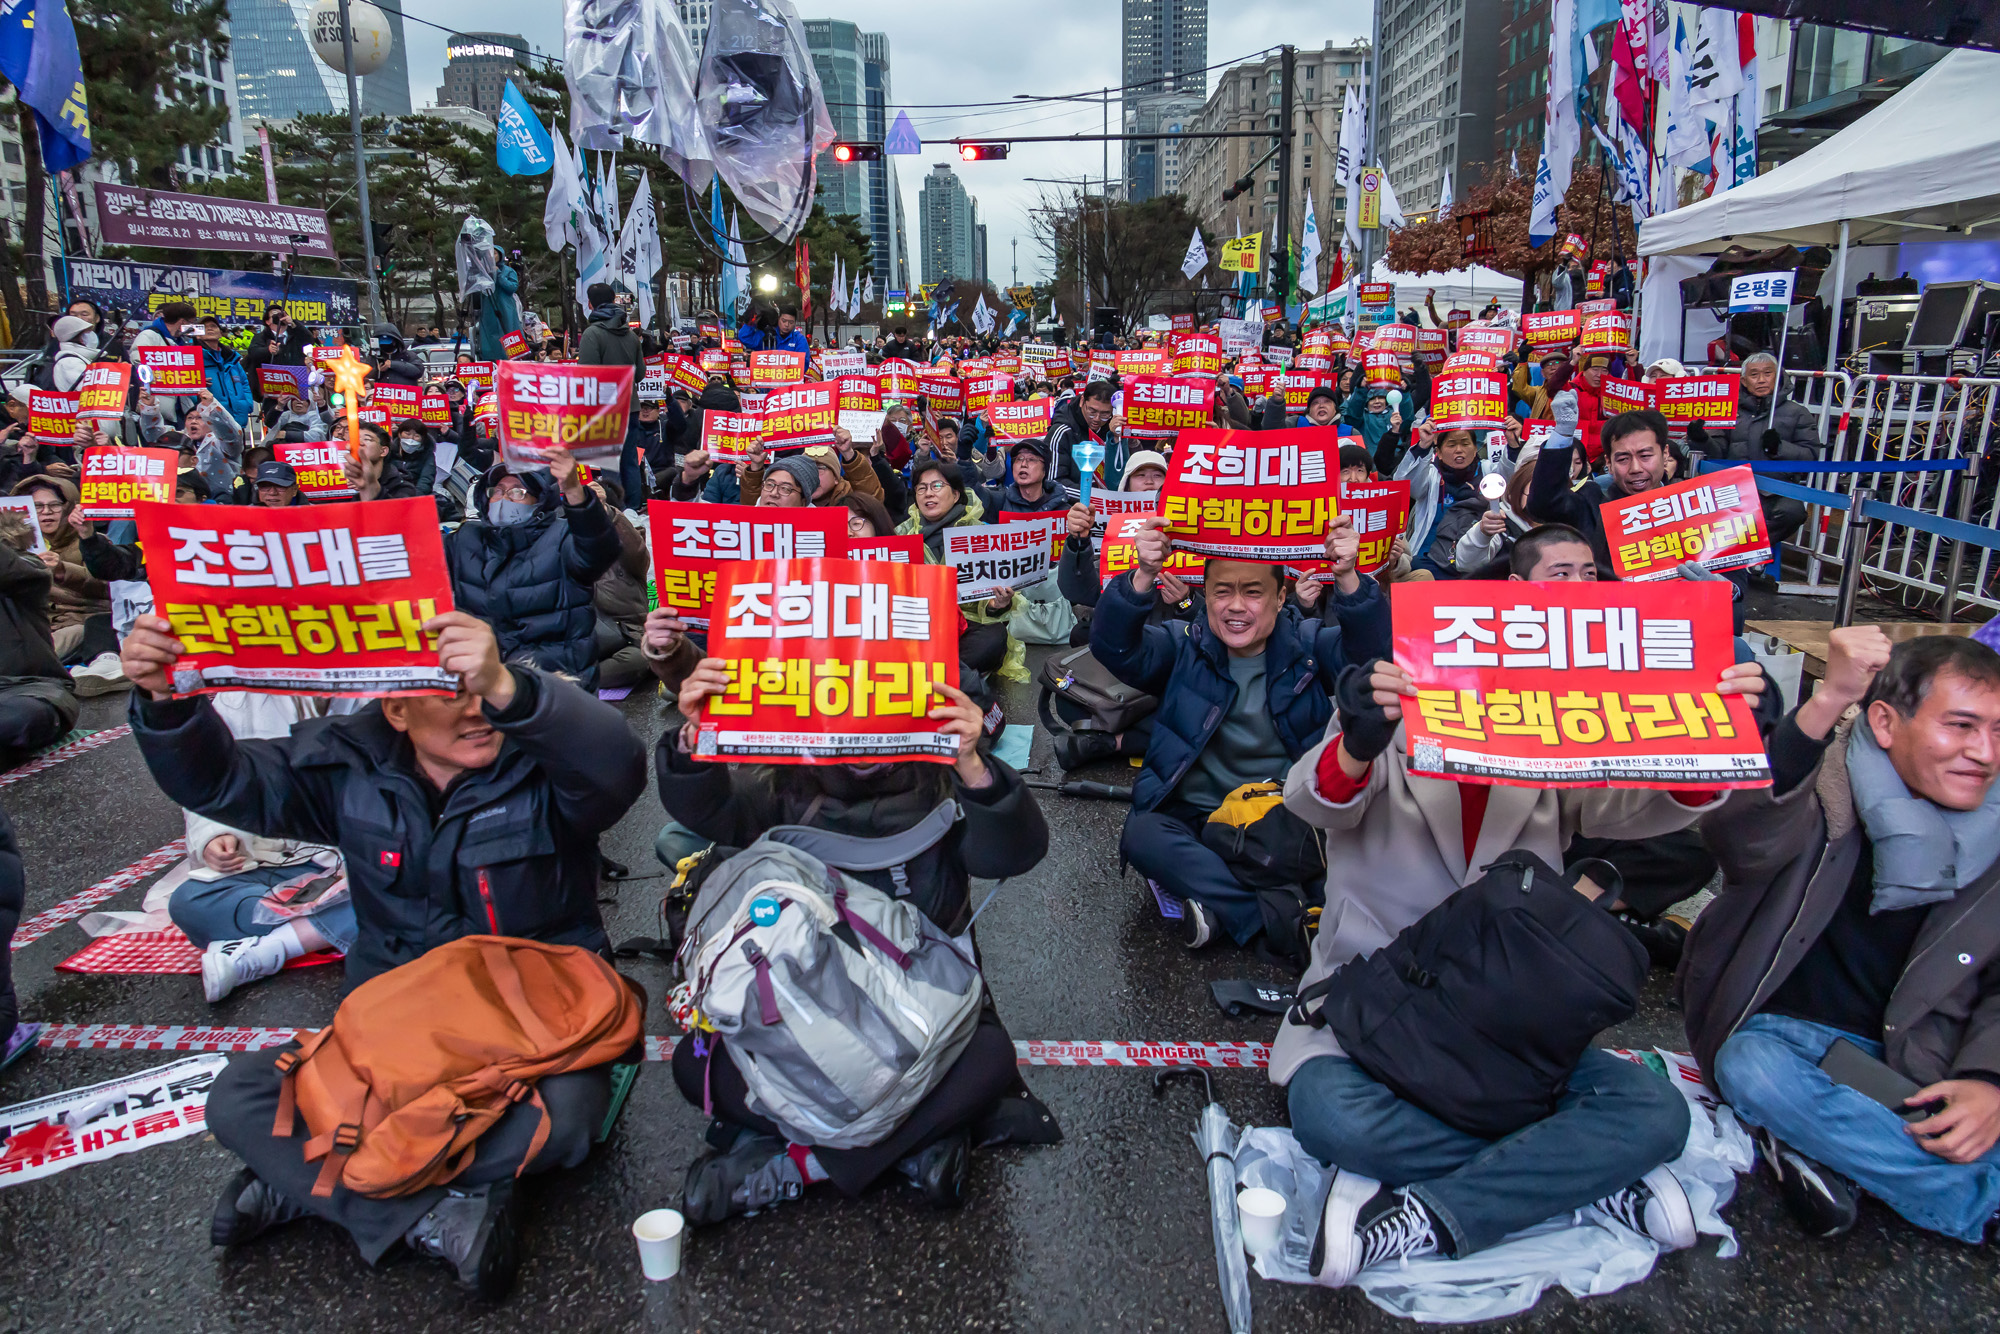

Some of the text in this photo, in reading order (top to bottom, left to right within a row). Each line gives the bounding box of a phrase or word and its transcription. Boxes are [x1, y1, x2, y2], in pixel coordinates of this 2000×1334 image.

[731, 36, 754, 48] 212
[71, 262, 132, 290] 재판이
[1734, 278, 1787, 300] 은평을
[234, 298, 266, 320] 즉각
[1529, 314, 1574, 329] 조희대를
[1463, 332, 1505, 344] 조희대를
[1526, 327, 1577, 344] 탄핵하라!
[1177, 339, 1217, 354] 조희대를
[144, 352, 195, 366] 조희대를
[757, 354, 799, 366] 조희대를
[825, 356, 863, 367] 특별재판부
[1121, 353, 1162, 362] 조희대를
[1173, 356, 1219, 372] 탄핵하라!
[1449, 354, 1490, 367] 조희대를
[83, 369, 121, 386] 희대를
[152, 370, 202, 384] 핵하라!
[460, 366, 490, 375] 조희대를
[753, 368, 800, 380] 탄핵하라!
[877, 362, 913, 377] 조희대를
[1093, 365, 1112, 376] 특별재
[1366, 369, 1400, 382] 탄핵하라
[513, 372, 617, 406] 조희대를
[637, 381, 662, 391] 하라!
[840, 380, 876, 395] 희대를
[881, 379, 918, 391] 핵하라!
[919, 382, 960, 397] 조희대를
[968, 378, 1007, 394] 조희대를
[1438, 378, 1500, 398] 조희대를
[1605, 381, 1644, 401] 조희대를
[1665, 381, 1729, 398] 조희대를
[80, 390, 123, 408] 핵하라!
[376, 387, 416, 401] 조희대를
[765, 389, 830, 415] 조희대를
[1133, 383, 1204, 405] 조희대를
[839, 397, 878, 411] 핵하라!
[995, 405, 1043, 419] 조희대를
[1433, 399, 1504, 419] 탄핵하라!
[1660, 401, 1732, 418] 탄핵하라!
[358, 410, 386, 423] 희대를
[761, 410, 836, 437] 탄핵하라!
[1128, 406, 1207, 428] 탄핵하라!
[508, 410, 621, 444] 탄핵하라!
[993, 420, 1048, 437] 탄핵하라!
[707, 434, 756, 451] 탄핵하
[86, 454, 165, 476] 조희대를
[1180, 444, 1327, 487] 조희대를
[81, 482, 169, 504] 탄핵하라!
[1090, 497, 1156, 515] 특별재판
[1619, 485, 1741, 535] 조희대를
[1163, 496, 1339, 538] 탄핵하라!
[1341, 508, 1387, 534] 대를
[672, 518, 826, 560] 조희대를
[950, 526, 1047, 553] 특별재판부
[1618, 513, 1758, 571] 탄핵하라!
[168, 526, 411, 588] 조희대를
[956, 550, 1046, 584] 설치하라!
[725, 580, 930, 640] 조희대를
[166, 599, 440, 655] 탄핵하라!
[1432, 605, 1695, 672] 조희대를
[709, 657, 945, 718] 탄핵하라!
[1417, 689, 1735, 746] 탄핵하라!
[886, 736, 911, 744] 모이자!
[1479, 756, 1699, 769] 내란청산! 국민주권실현! 촛불대행진으로 모이자!
[1610, 770, 1625, 778] ARS
[178, 1029, 259, 1044] DANGER!
[1029, 1046, 1206, 1060] 안전제일 DANGER!
